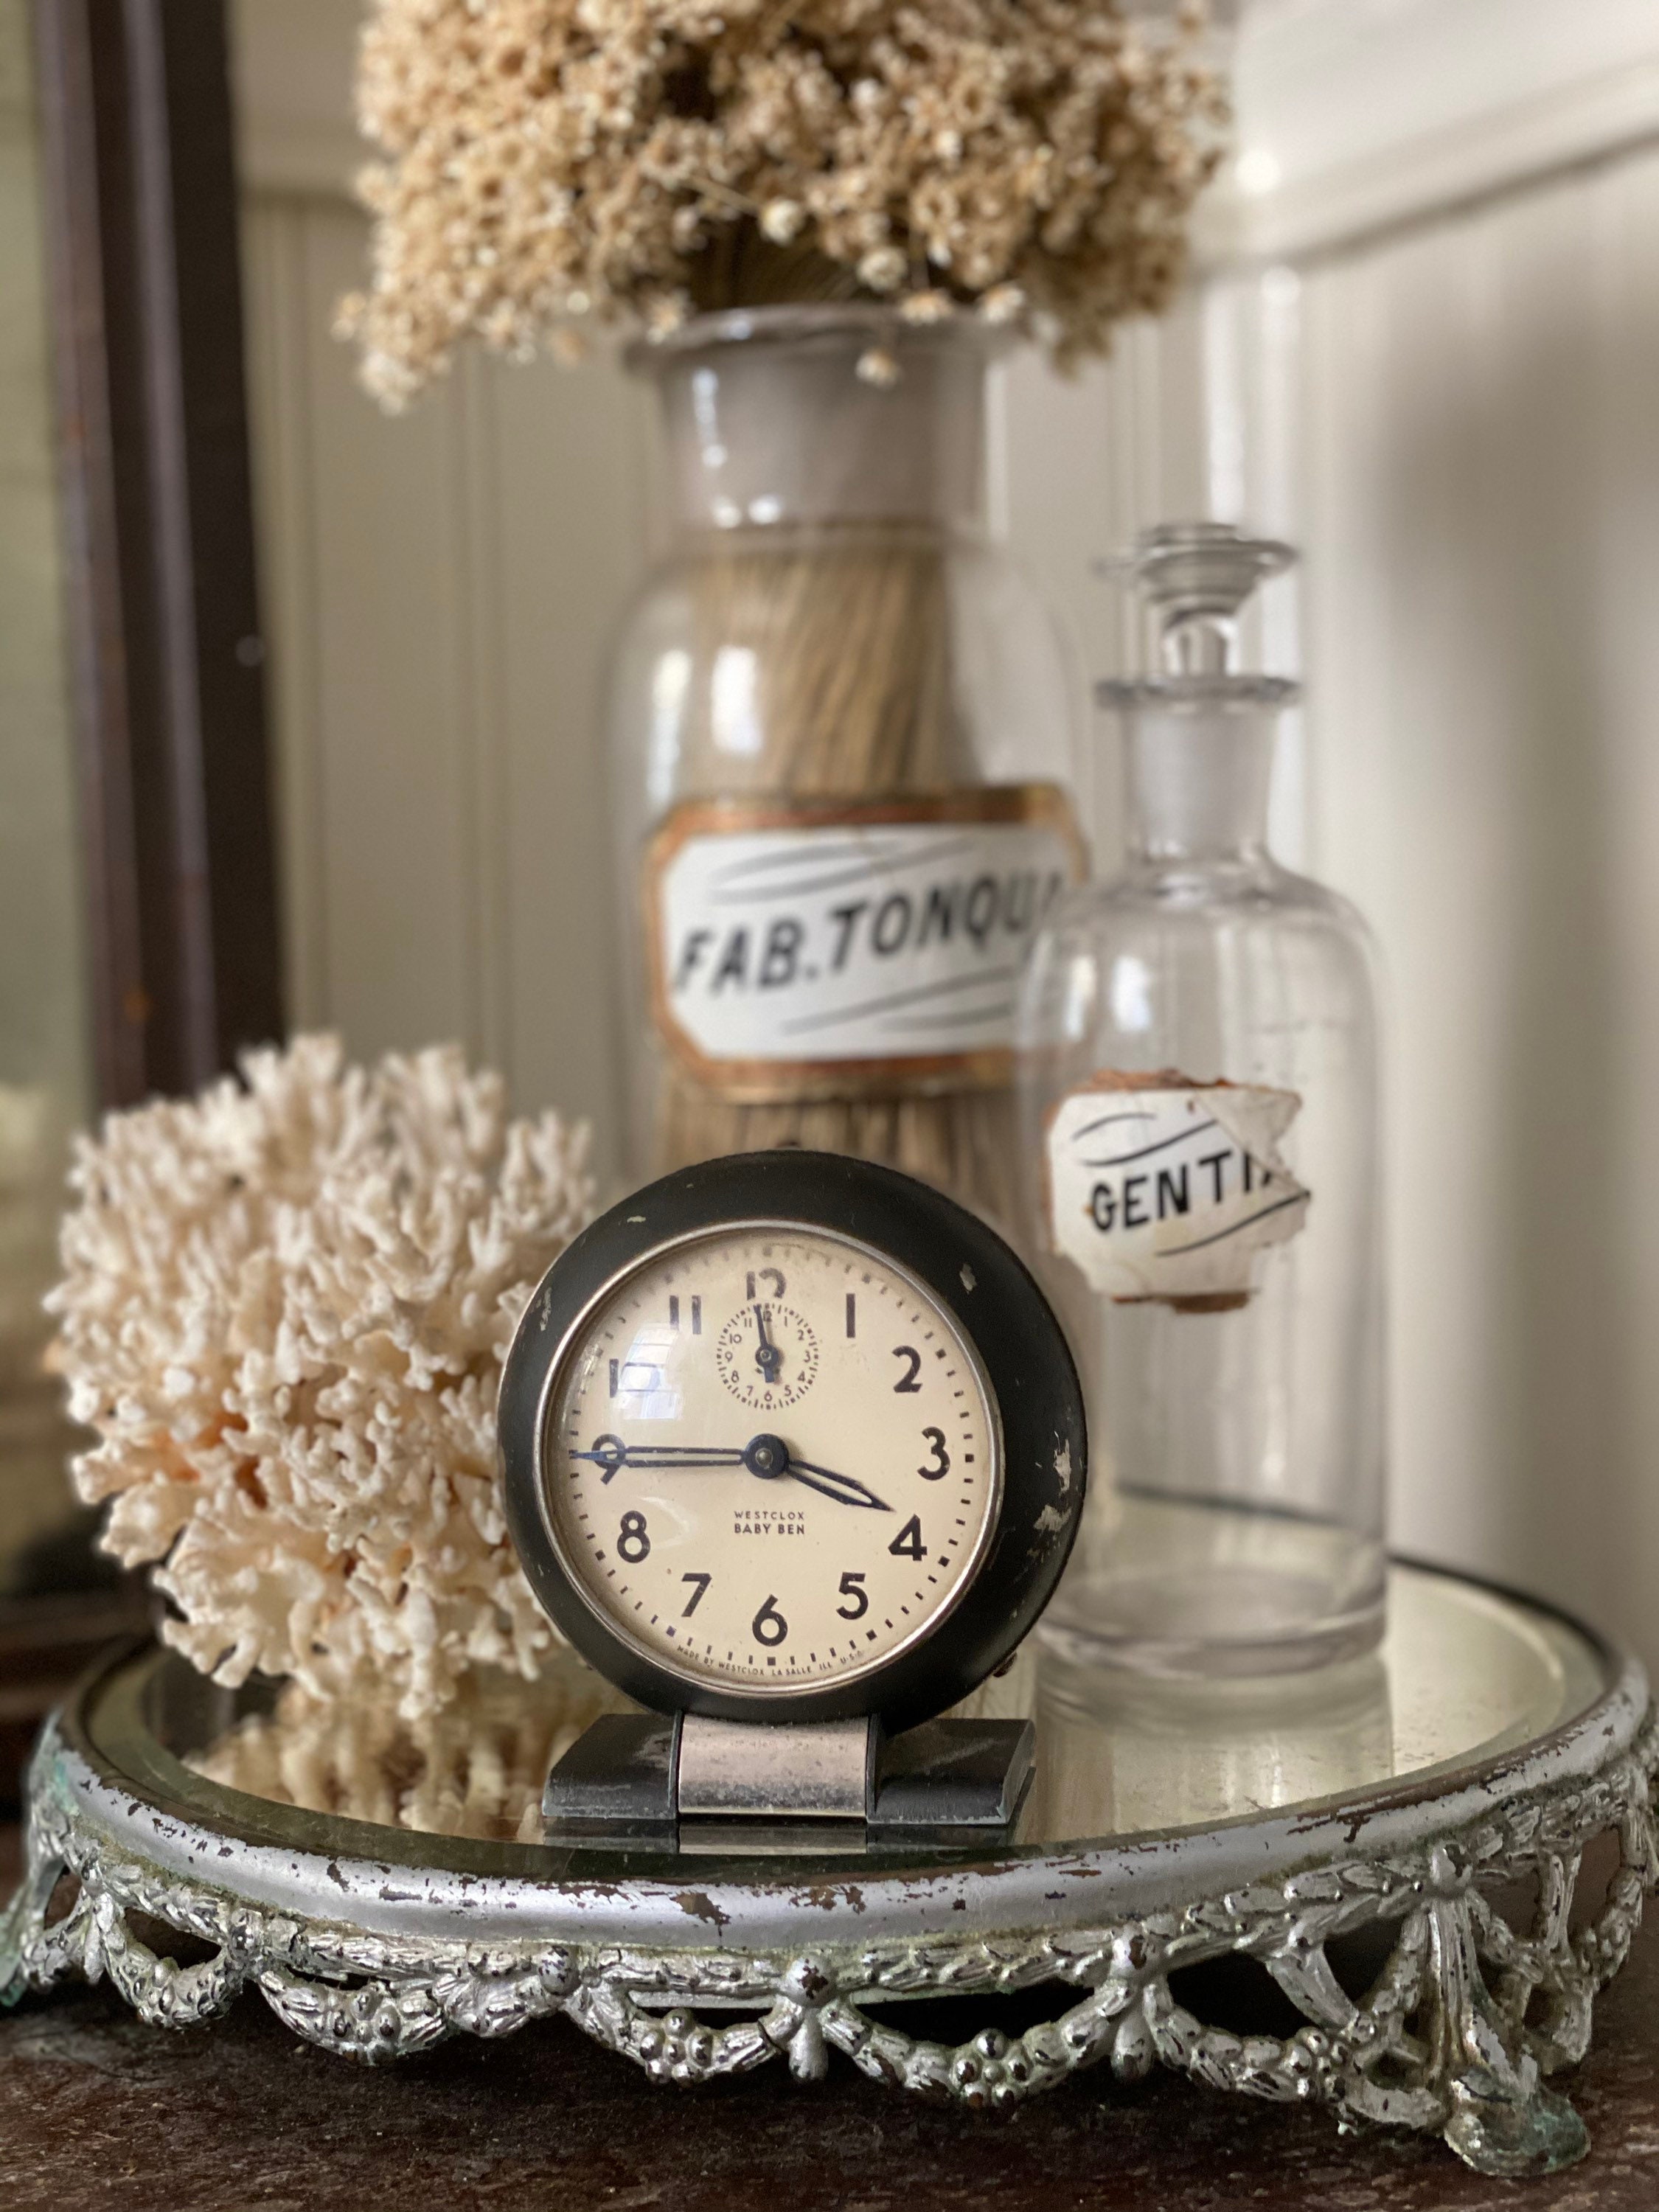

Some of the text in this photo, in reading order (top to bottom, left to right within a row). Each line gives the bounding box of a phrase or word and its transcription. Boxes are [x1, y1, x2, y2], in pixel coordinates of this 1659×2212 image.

[1089, 1149, 1273, 1233] GENTI
[669, 1295, 701, 1335] 11
[743, 1318, 752, 1328] 11
[846, 1293, 856, 1338] 1
[729, 1334, 742, 1343] 10
[797, 1329, 804, 1340] 2
[724, 1351, 733, 1363] 9
[804, 1351, 811, 1363] 3
[731, 1370, 740, 1382] 8
[797, 1371, 805, 1382] 4
[893, 1346, 922, 1393] 2
[747, 1385, 754, 1397] 7
[763, 1390, 773, 1402] 6
[784, 1385, 792, 1397] 5
[591, 1433, 626, 1485] 9
[917, 1427, 950, 1481] 3
[734, 1510, 804, 1520] WESTCLOX
[616, 1510, 651, 1564] 8
[734, 1523, 805, 1534] BABY BEN
[888, 1514, 927, 1561] 4
[681, 1573, 712, 1617] 7
[836, 1573, 869, 1620] 5
[751, 1594, 787, 1647] 6
[677, 1644, 700, 1660] MADE
[703, 1656, 714, 1665] BY
[718, 1661, 765, 1676] WESTCLOX
